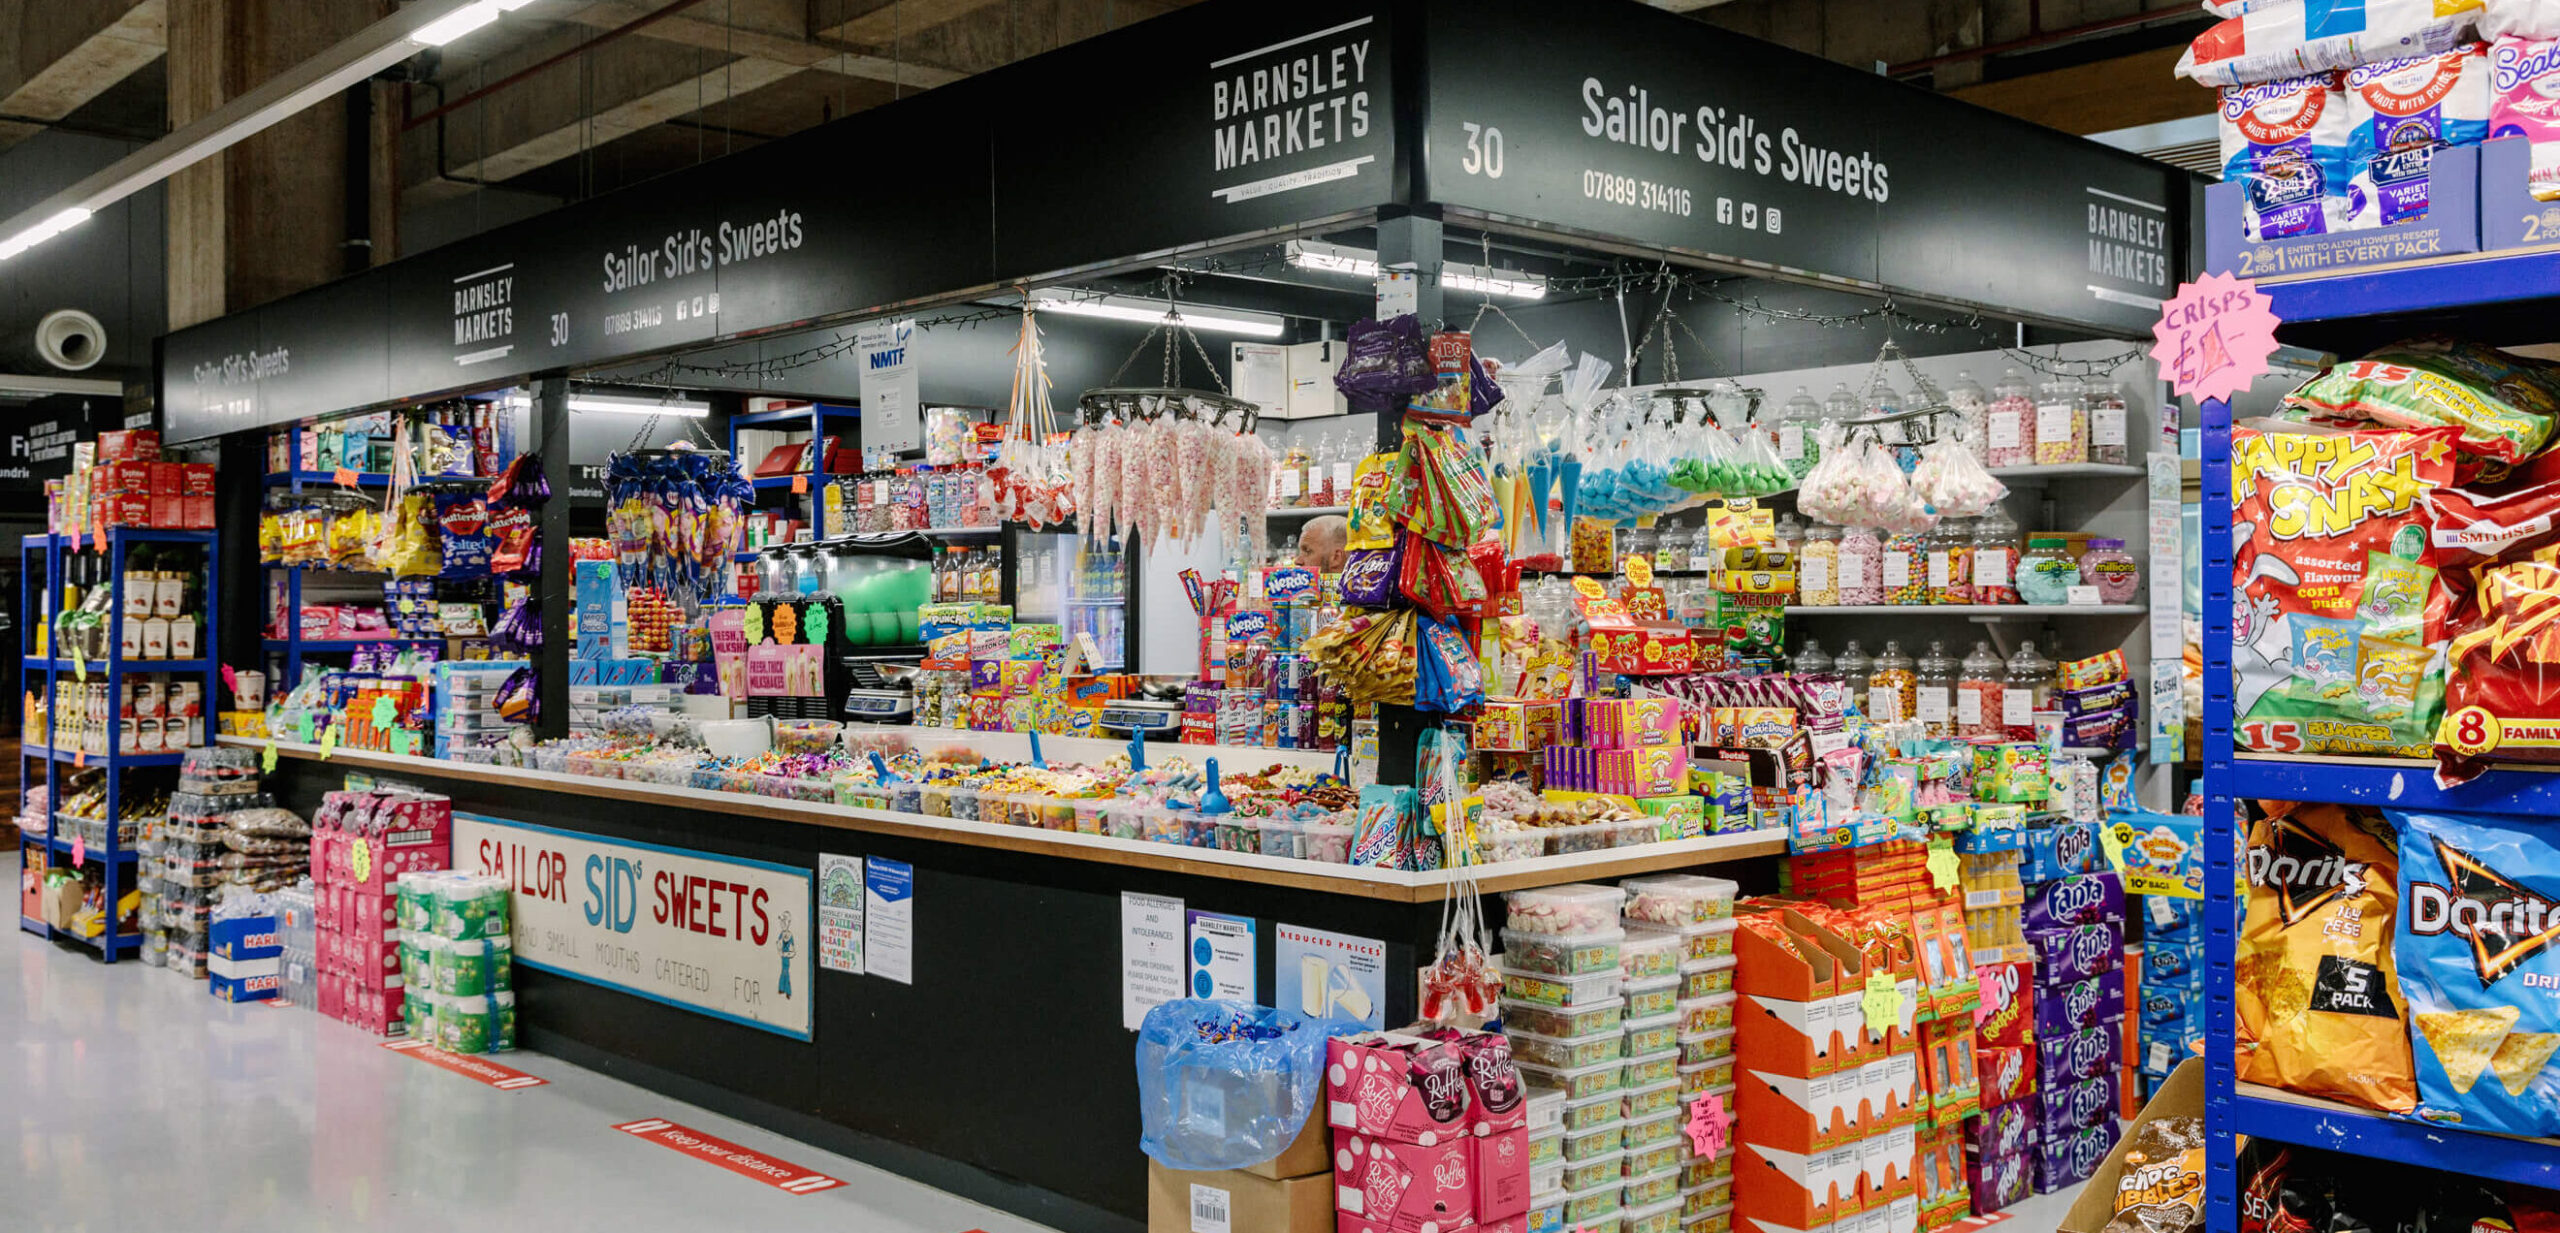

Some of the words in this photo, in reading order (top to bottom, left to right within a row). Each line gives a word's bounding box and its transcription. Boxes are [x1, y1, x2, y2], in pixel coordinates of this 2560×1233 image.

[1214, 39, 1370, 121] BARNSLEY
[2370, 90, 2394, 110] MADE
[2398, 95, 2425, 111] WITH
[2428, 70, 2452, 100] PRIDE
[1215, 91, 1369, 171] MARKETS
[2244, 121, 2267, 138] MADE
[2270, 125, 2296, 140] WITH
[2297, 101, 2319, 131] PRIDE
[1463, 121, 1504, 179] 30
[1582, 77, 1687, 154] Sailor
[1696, 106, 1772, 175] Sid's
[1781, 127, 1889, 203] Sweets
[1304, 168, 1342, 181] TRADITION
[1584, 170, 1635, 206] 07889
[1640, 181, 1691, 217] 314116
[2389, 184, 2428, 198] VARIET
[2398, 192, 2429, 204] PACK
[2088, 204, 2165, 249] BARNSLEY
[2270, 205, 2311, 223] VARIETY
[2278, 215, 2305, 228] PACK
[2522, 214, 2541, 242] 2
[604, 245, 660, 293] Sailor
[664, 229, 713, 279] Sid's
[718, 208, 802, 265] Sweets
[2287, 245, 2315, 255] ENTRY
[2317, 242, 2329, 251] TO
[2331, 238, 2360, 250] ALTON
[2363, 232, 2399, 245] TOWERS
[2402, 229, 2440, 240] RESORT
[2288, 253, 2331, 269] WITH
[2336, 245, 2392, 263] EVERY
[2395, 238, 2441, 257] PACK
[2088, 239, 2165, 286] MARKETS
[2238, 252, 2254, 275] 2
[2255, 263, 2276, 273] FOR
[2275, 247, 2285, 271] 1
[454, 277, 513, 315] BARNSLEY
[2166, 289, 2251, 331] CRISPS
[455, 308, 512, 345] MARKETS
[551, 312, 568, 347] 30
[605, 310, 632, 336] 07889
[194, 361, 222, 384] Sailor
[223, 354, 247, 385] Sid's
[249, 346, 289, 380] Sweets
[871, 348, 904, 369] NMTF
[2349, 361, 2416, 385] 15
[2232, 432, 2376, 506] HAPPY
[2270, 453, 2440, 541] SNAX
[2459, 525, 2524, 543] SMITHS
[2034, 562, 2079, 573] millions
[2096, 562, 2136, 573] millions
[2295, 555, 2361, 571] assorted
[1269, 573, 1310, 593] Nerds
[2297, 585, 2340, 598] corn
[2304, 572, 2361, 584] flavour
[1734, 594, 1783, 606] MELON
[2312, 597, 2352, 610] puffs
[1230, 617, 1265, 635] Nerds
[716, 642, 747, 653] MILKSHA
[1556, 655, 1572, 668] Dip
[768, 660, 783, 673] THICK
[750, 675, 785, 690] MILKSHAKES
[2153, 676, 2178, 696] SLUSH
[1742, 723, 1769, 738] Cookie
[1768, 723, 1793, 737] Dough
[2242, 721, 2302, 752] 15
[2458, 711, 2486, 745] 8
[2503, 727, 2560, 740] FAMILY
[2057, 827, 2090, 870] Fanta
[479, 838, 567, 904] SAILOR
[584, 852, 643, 935] SID'S
[653, 869, 770, 946] SWEETS
[2048, 877, 2104, 919] Fanta
[2148, 881, 2170, 890] BAGS
[1145, 914, 1159, 923] AND
[2412, 884, 2560, 936] Dorit
[244, 933, 277, 949] HARI
[1131, 927, 1173, 940] INTOLERANCES
[1280, 931, 1332, 947] REDUCED
[1339, 942, 1380, 957] PRICES
[2072, 925, 2111, 972] Fanta
[516, 927, 538, 949] AND
[546, 931, 579, 959] SMALL
[595, 943, 640, 975] MOUTHS
[655, 956, 710, 992] CATERED
[733, 976, 761, 1005] FOR
[2345, 967, 2370, 992] 5
[245, 976, 278, 992] HARI
[2066, 985, 2097, 1024] Fanta
[2331, 992, 2374, 1009] PACK
[2070, 1030, 2109, 1077] Fanta
[2070, 1081, 2109, 1128] Fanta
[659, 1130, 700, 1145] Keep
[687, 1142, 734, 1156] your
[726, 1153, 792, 1178] distance
[2070, 1129, 2109, 1178] Fanta
[1434, 1160, 1466, 1192] Ruffles
[2115, 1172, 2200, 1213] IBBLES
